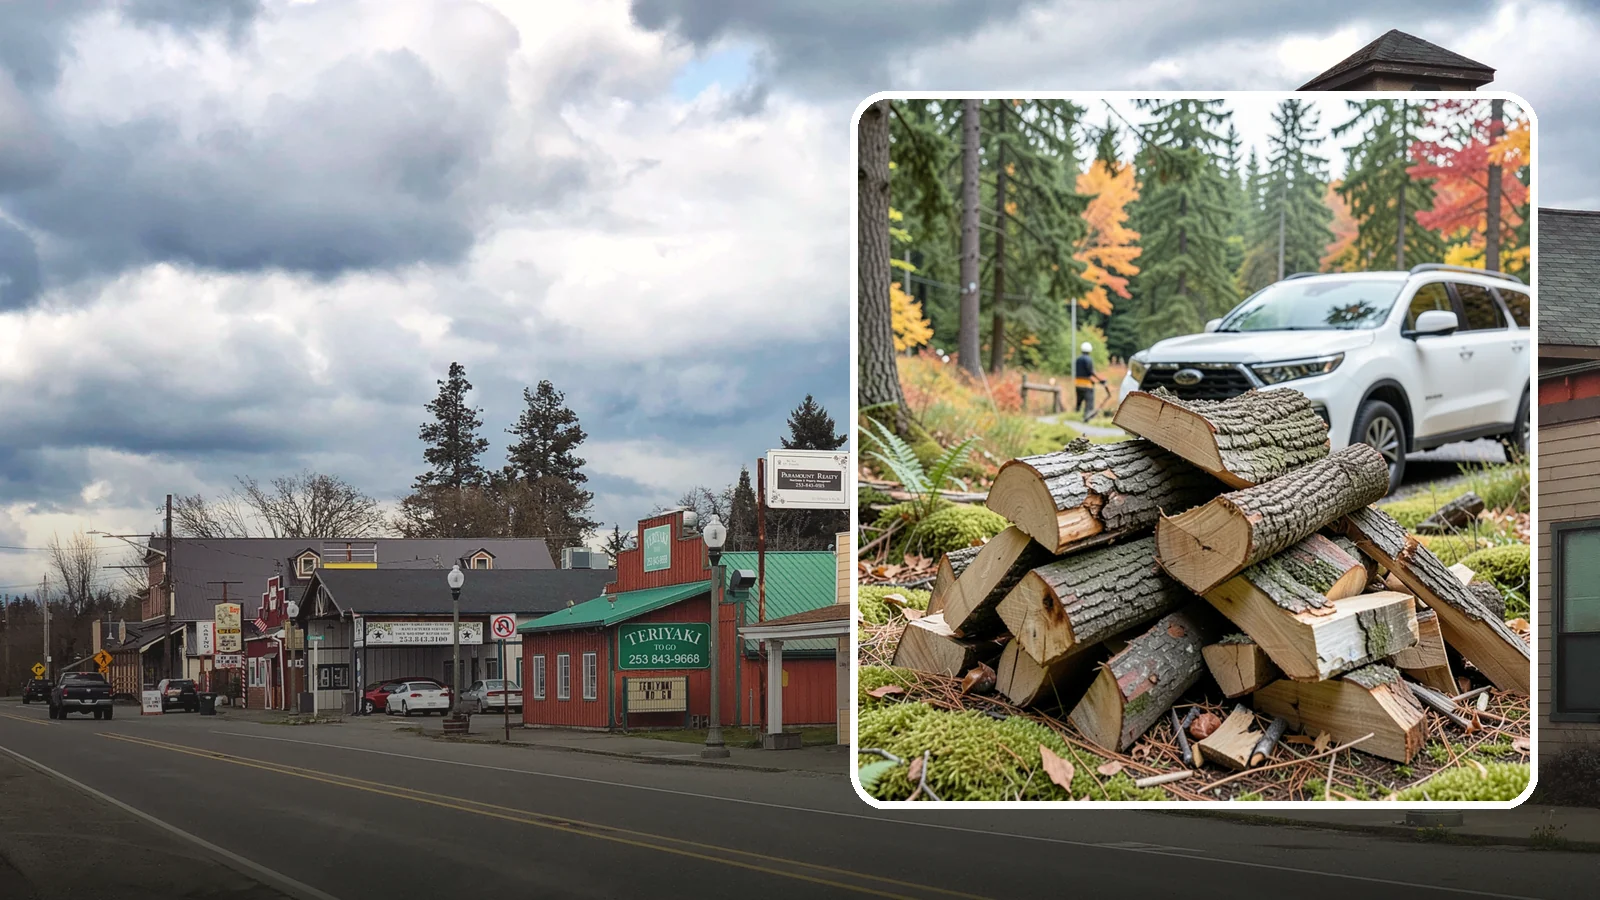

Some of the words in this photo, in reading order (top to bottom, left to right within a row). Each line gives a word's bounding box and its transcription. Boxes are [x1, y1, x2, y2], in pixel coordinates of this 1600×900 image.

[781, 471, 815, 479] PARAMOUNT
[624, 627, 703, 646] TERIYAKI
[653, 643, 664, 651] TO
[665, 643, 676, 651] GO
[628, 654, 649, 665] 253
[651, 653, 700, 664] 843-9668
